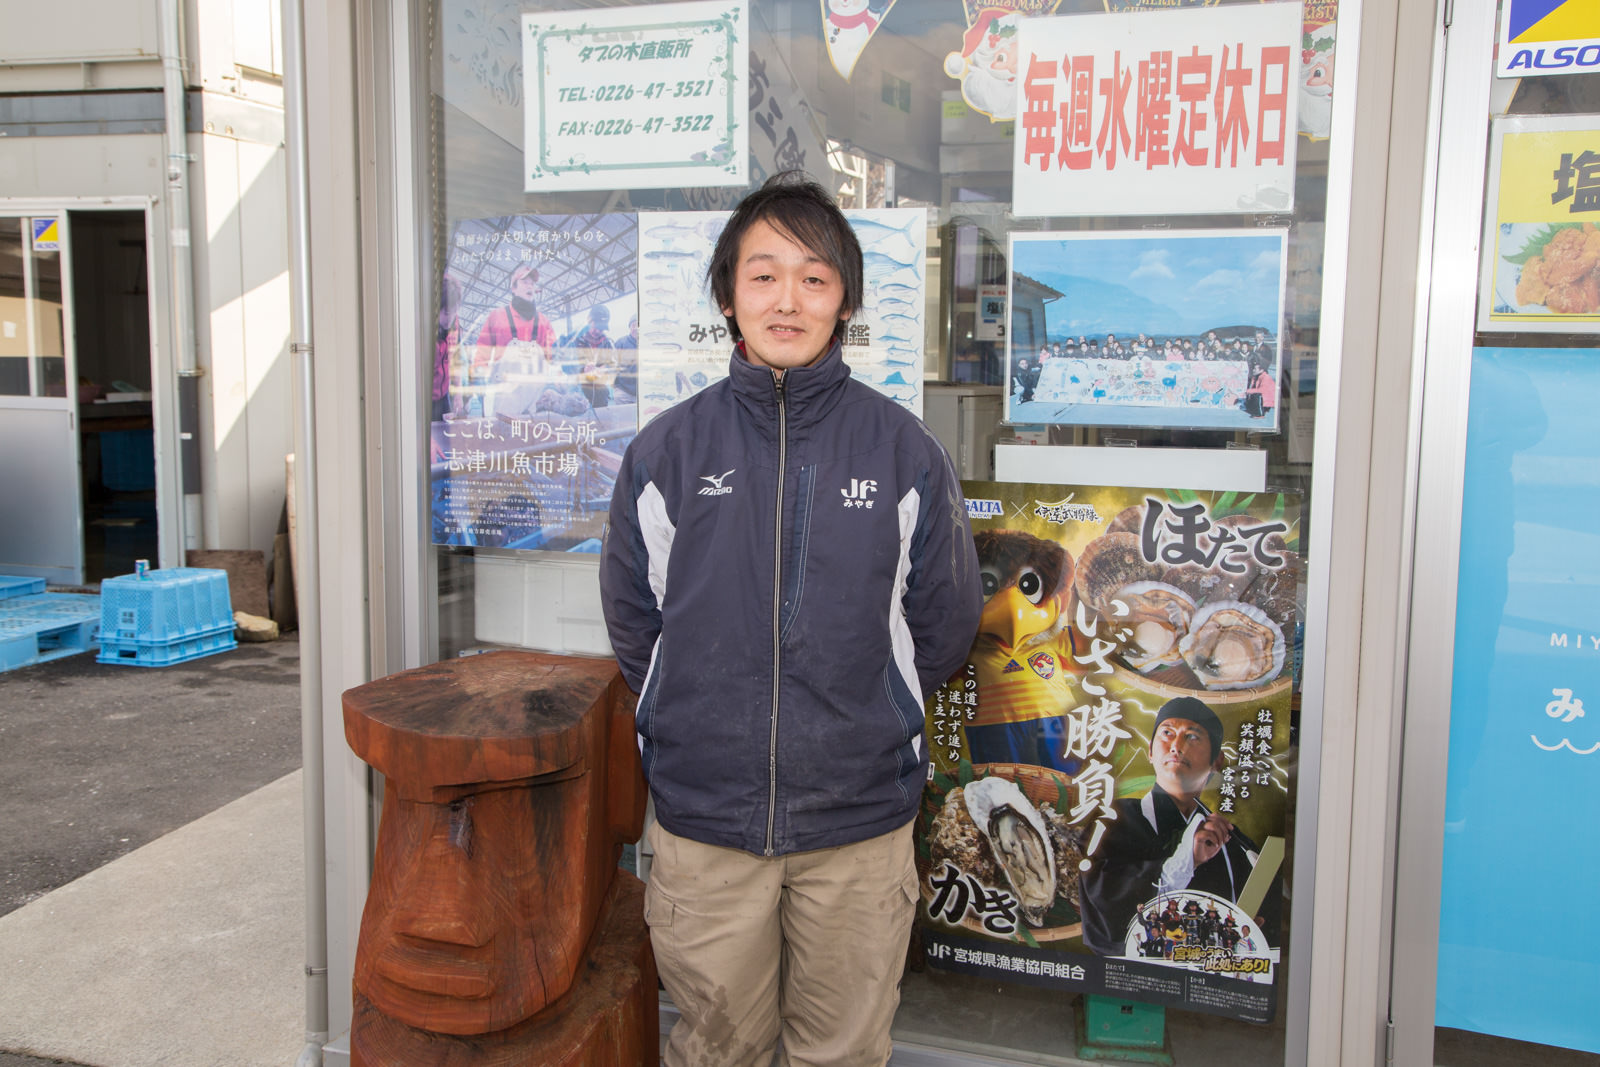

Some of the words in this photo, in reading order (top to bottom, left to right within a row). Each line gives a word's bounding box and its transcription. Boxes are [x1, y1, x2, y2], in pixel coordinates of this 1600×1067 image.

[558, 79, 714, 102] TEL:0226-47-3521
[1022, 42, 1291, 172] 毎週水曜定休日
[557, 114, 714, 136] FAX:0226-47-3522
[443, 418, 608, 446] ここは、町の台所。
[443, 448, 580, 476] 志津川魚市場
[843, 499, 875, 509] みやぎ
[1141, 497, 1288, 574] ほたて
[963, 664, 979, 721] この道を
[1545, 687, 1586, 723] み
[933, 682, 948, 746] を立てて
[948, 690, 963, 762] 迷わず進め
[1219, 766, 1236, 813] 宮城産
[928, 863, 1018, 934] かき
[954, 948, 1086, 981] 宮城県漁業協同組合
